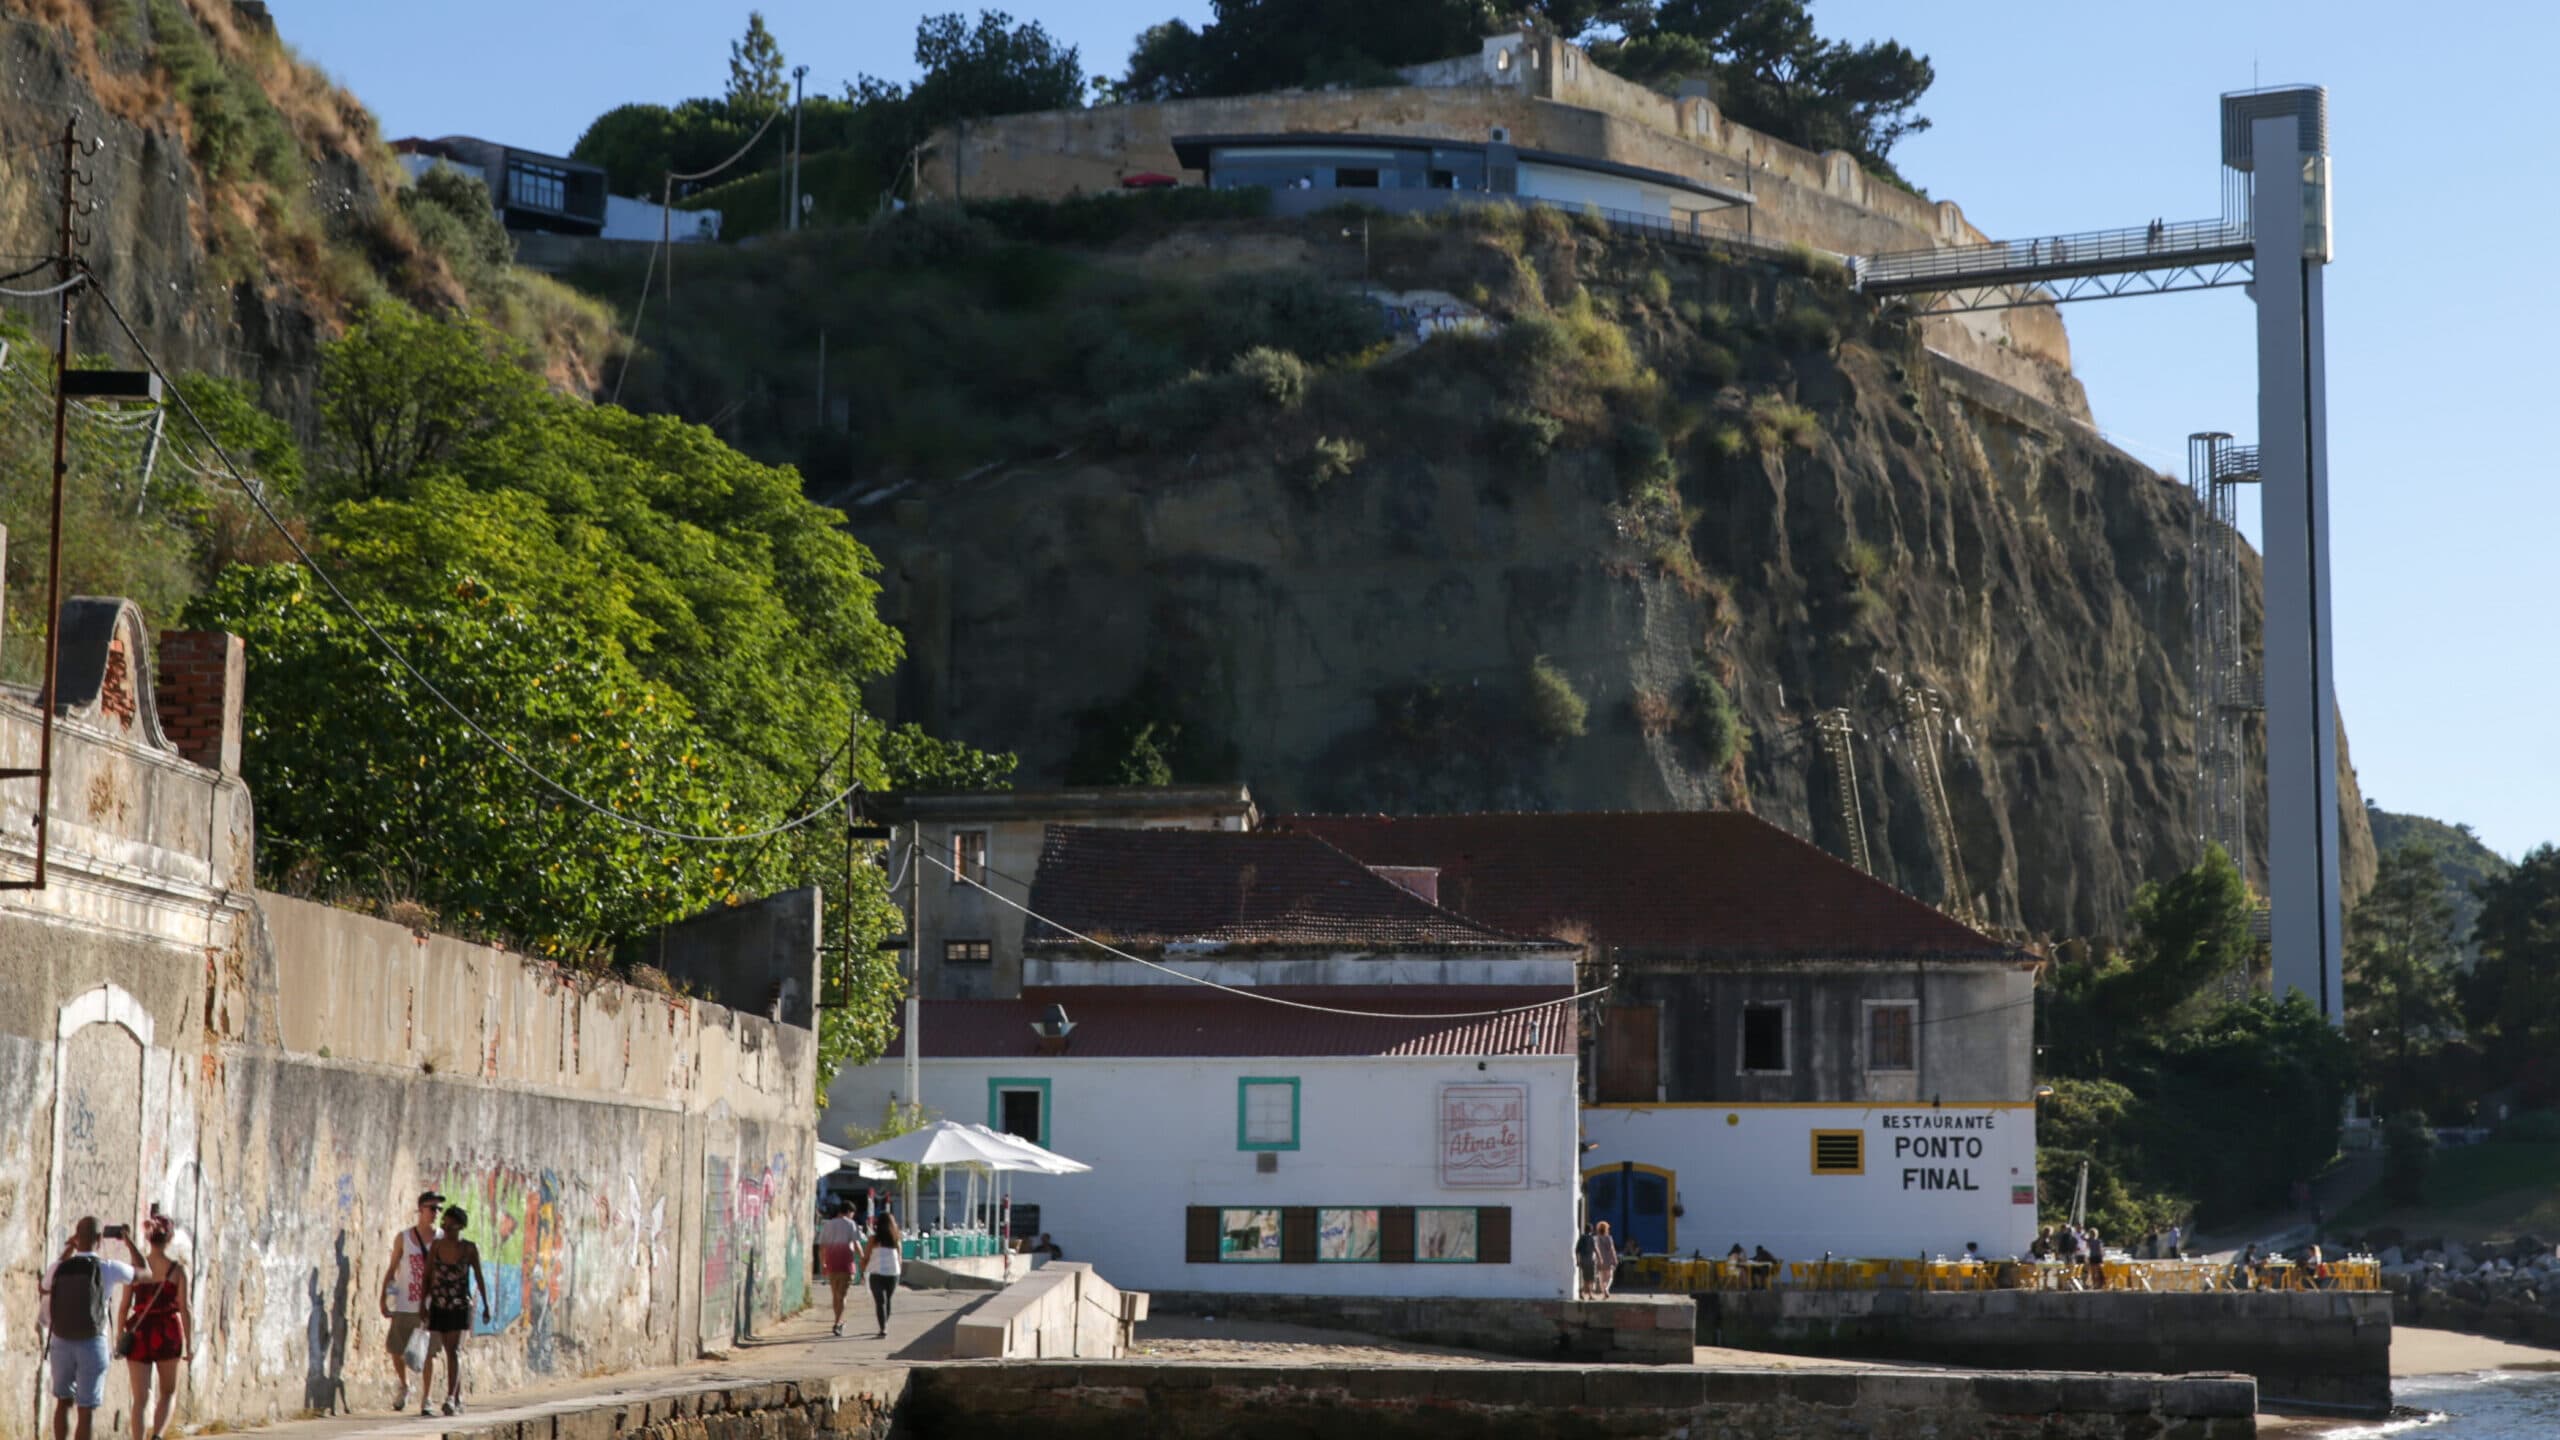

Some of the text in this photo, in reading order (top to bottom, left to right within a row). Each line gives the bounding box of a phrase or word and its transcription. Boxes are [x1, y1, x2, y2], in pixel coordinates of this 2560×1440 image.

[1882, 1115, 1995, 1129] RESTAURANTE
[1895, 1136, 1982, 1158] PONTO
[1903, 1168, 1979, 1190] FINAL
